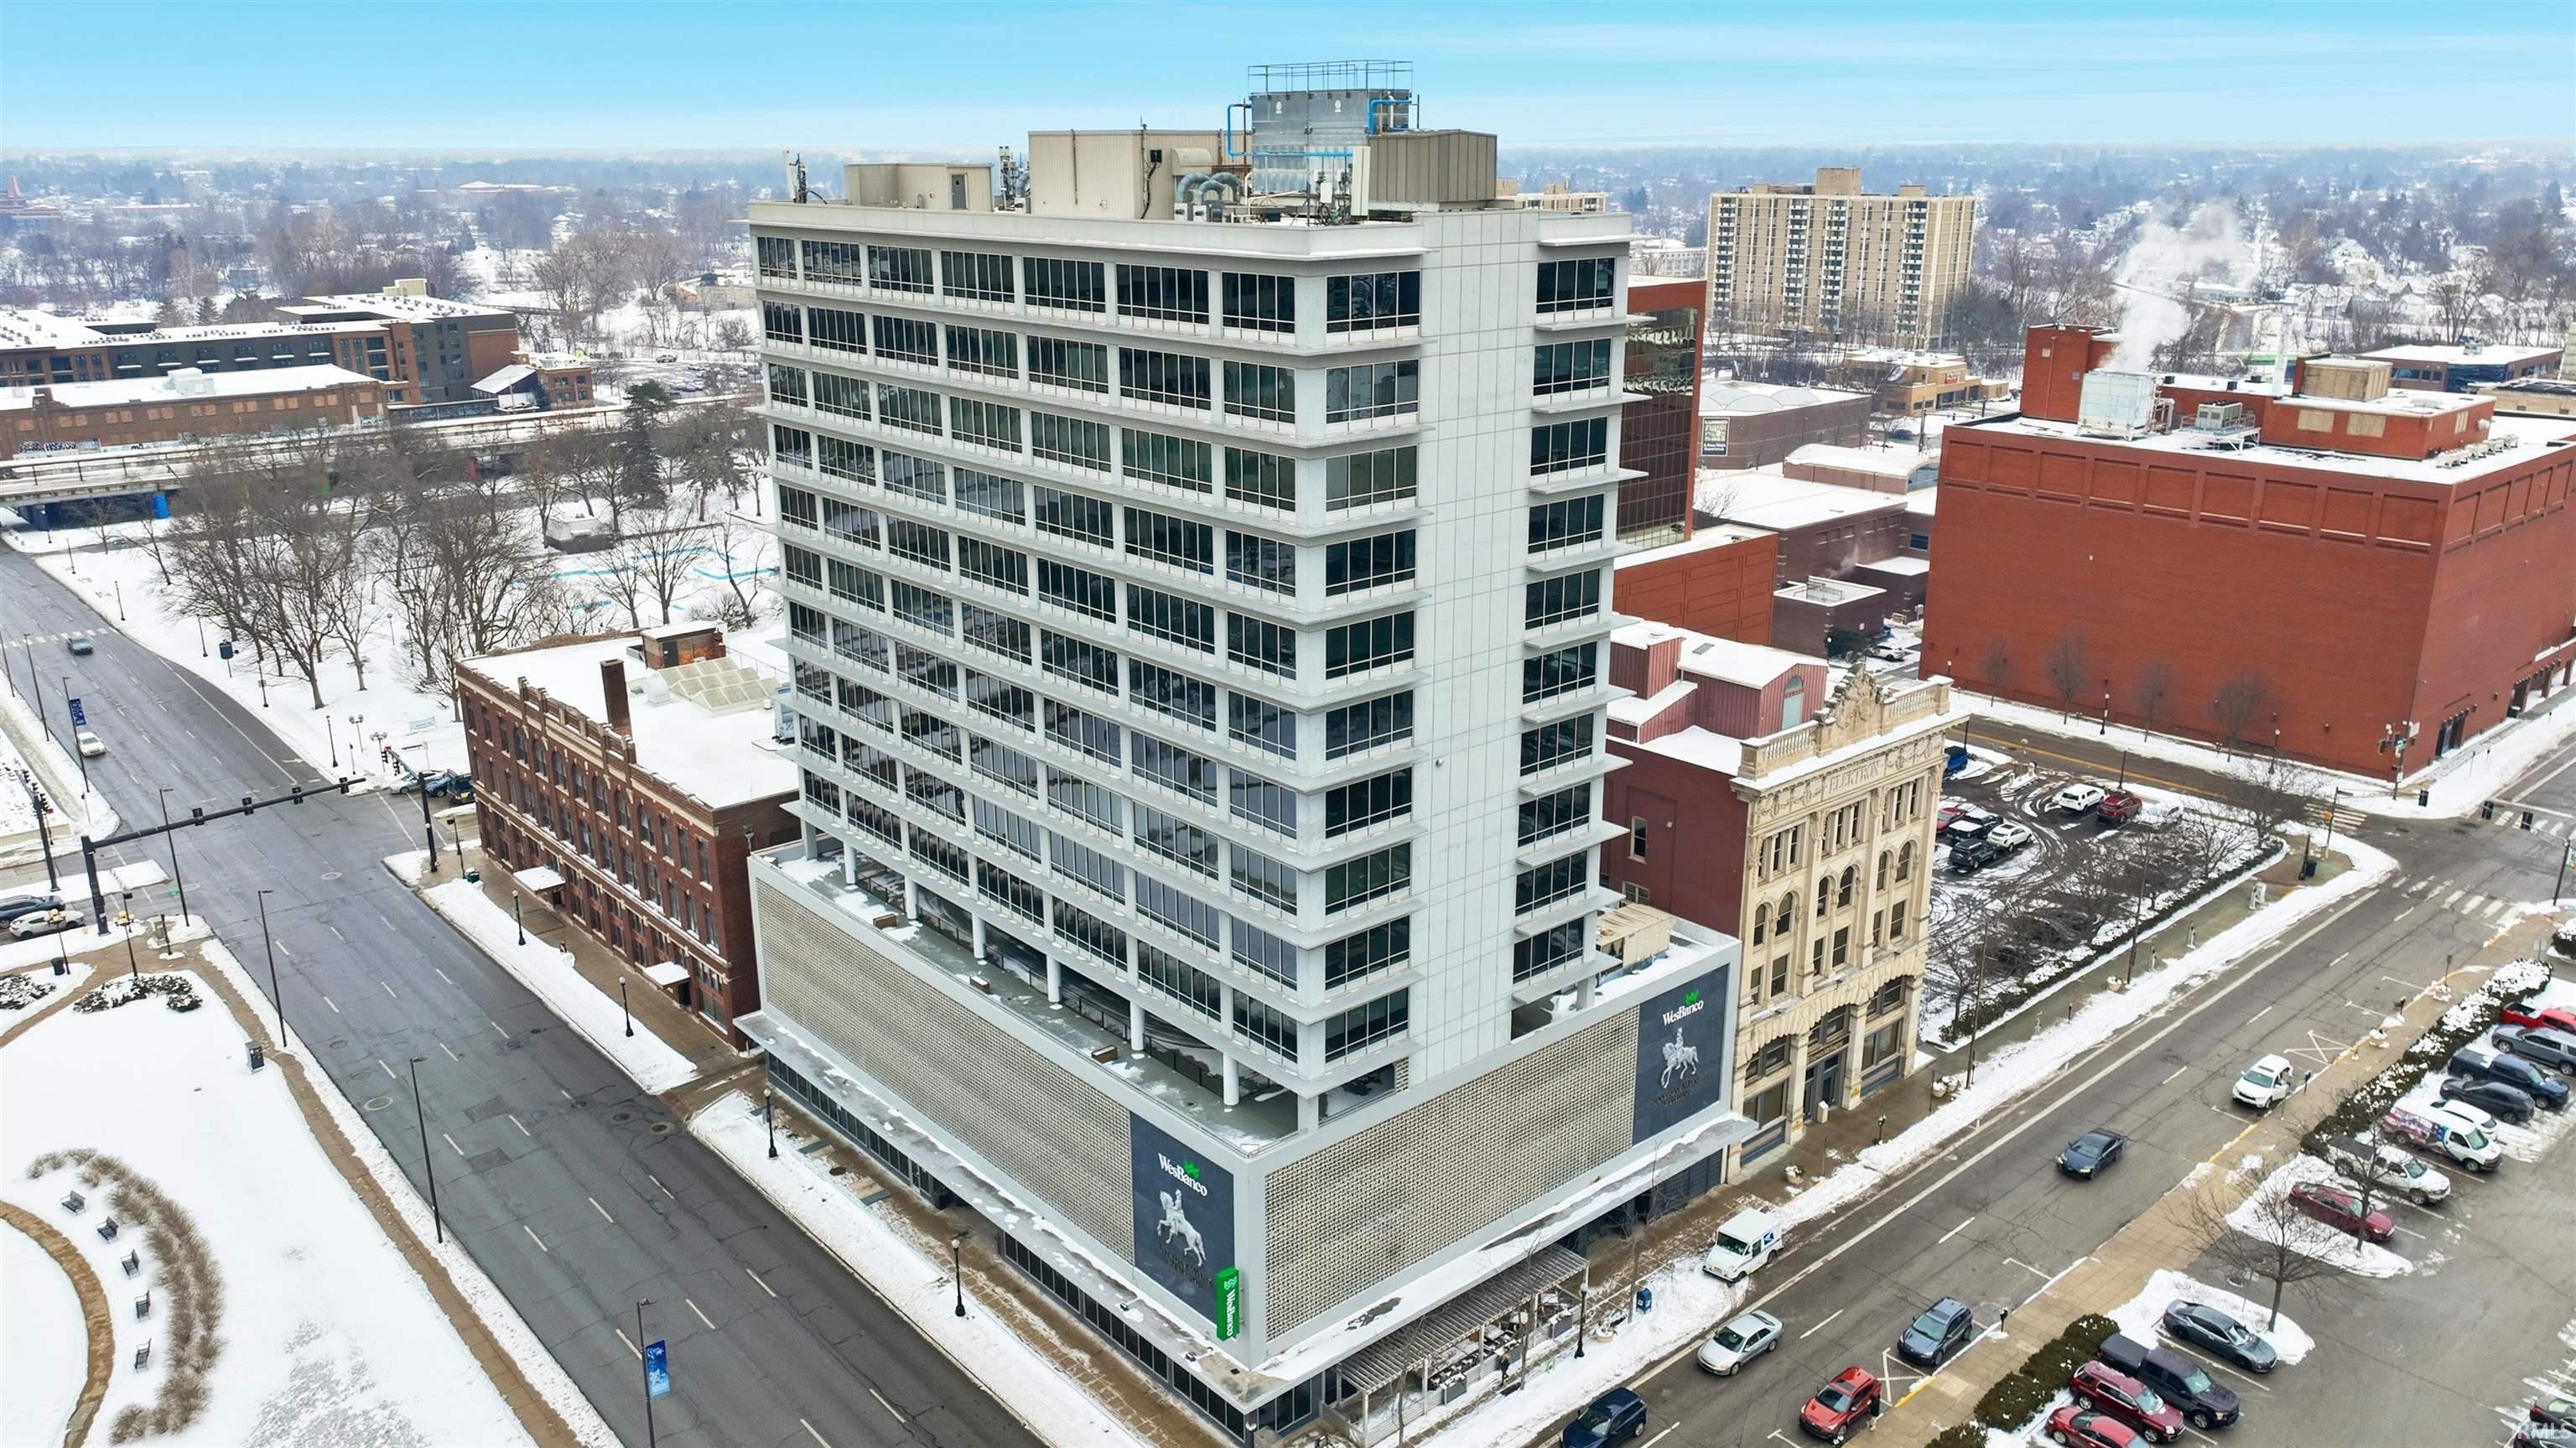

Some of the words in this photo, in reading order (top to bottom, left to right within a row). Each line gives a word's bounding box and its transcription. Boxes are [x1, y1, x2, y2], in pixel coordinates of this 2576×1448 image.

[1662, 1000, 1704, 1026] WesBanco
[1157, 1152, 1208, 1196] WesBanco
[1226, 1289, 1236, 1336] WesBanco
